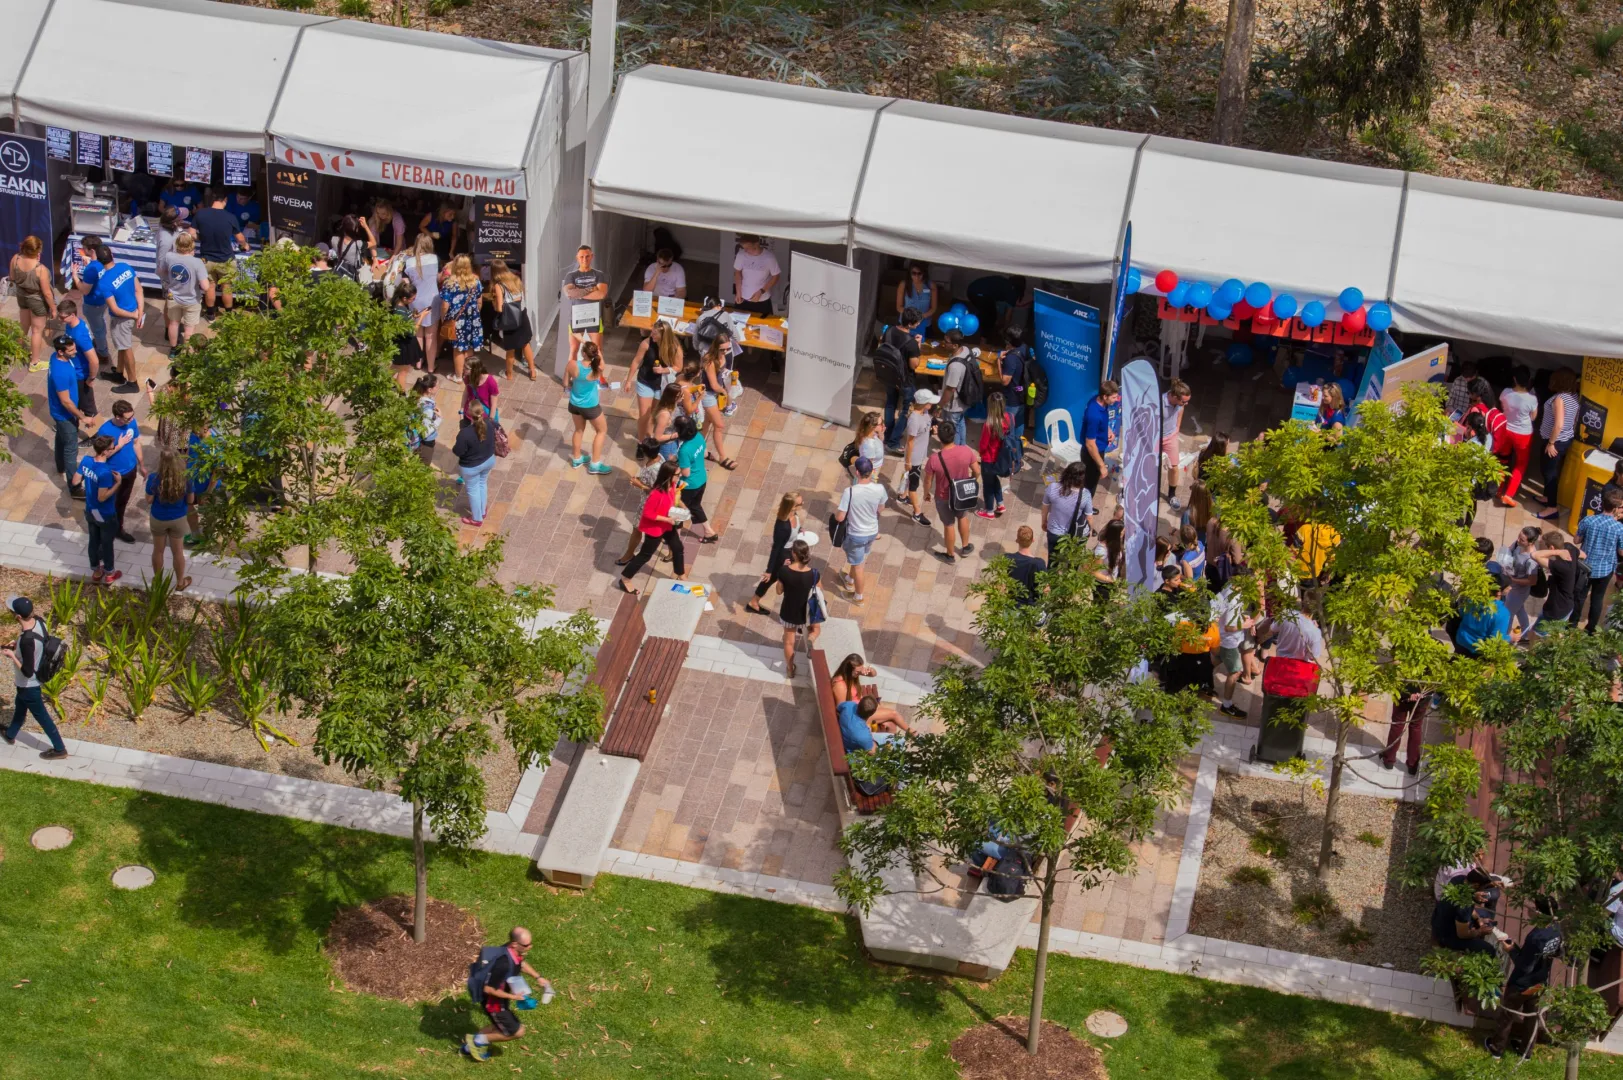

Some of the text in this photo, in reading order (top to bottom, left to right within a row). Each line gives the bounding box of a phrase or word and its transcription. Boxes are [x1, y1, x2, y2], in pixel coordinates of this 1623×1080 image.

[381, 161, 515, 196] EVEBAR.COM.AU
[272, 195, 313, 210] #EVEBAR
[478, 228, 523, 238] MOSSMAN
[792, 289, 856, 315] WOODFORD
[1073, 309, 1088, 319] ANZ
[1041, 330, 1092, 353] Net more with
[789, 346, 852, 369] #changingthegame
[1044, 341, 1089, 362] ANZ Student
[1584, 372, 1597, 384] BE
[1582, 415, 1602, 429] CEO
